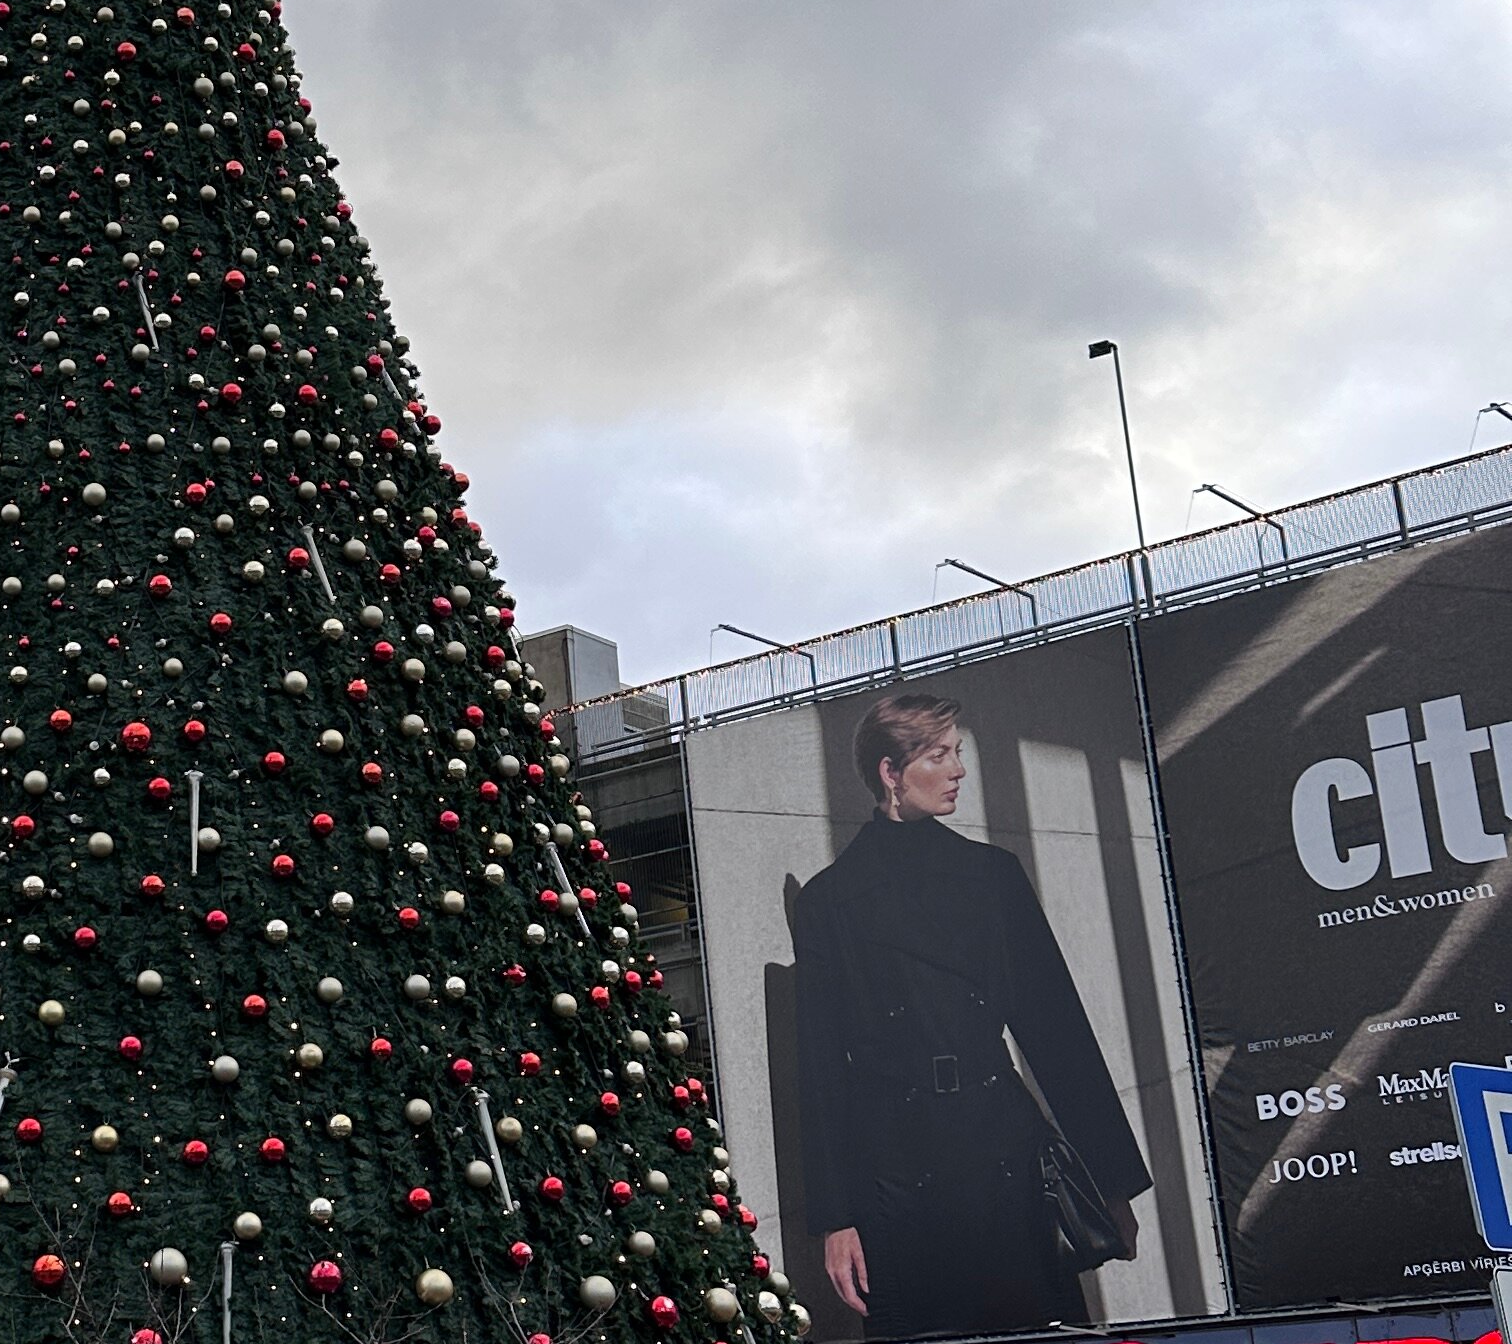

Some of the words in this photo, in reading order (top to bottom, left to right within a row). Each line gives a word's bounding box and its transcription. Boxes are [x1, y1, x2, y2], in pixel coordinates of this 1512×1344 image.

[1291, 693, 1512, 891] cit
[1317, 883, 1495, 929] men&women
[1367, 1016, 1419, 1033] GERARD
[1420, 1011, 1461, 1025] DAREL
[1247, 1038, 1281, 1053] BETTY
[1283, 1030, 1335, 1047] BARCLAY
[1255, 1084, 1347, 1121] BOSS
[1269, 1150, 1358, 1184] JOOP!
[1403, 1260, 1466, 1277] APĢĒRBI
